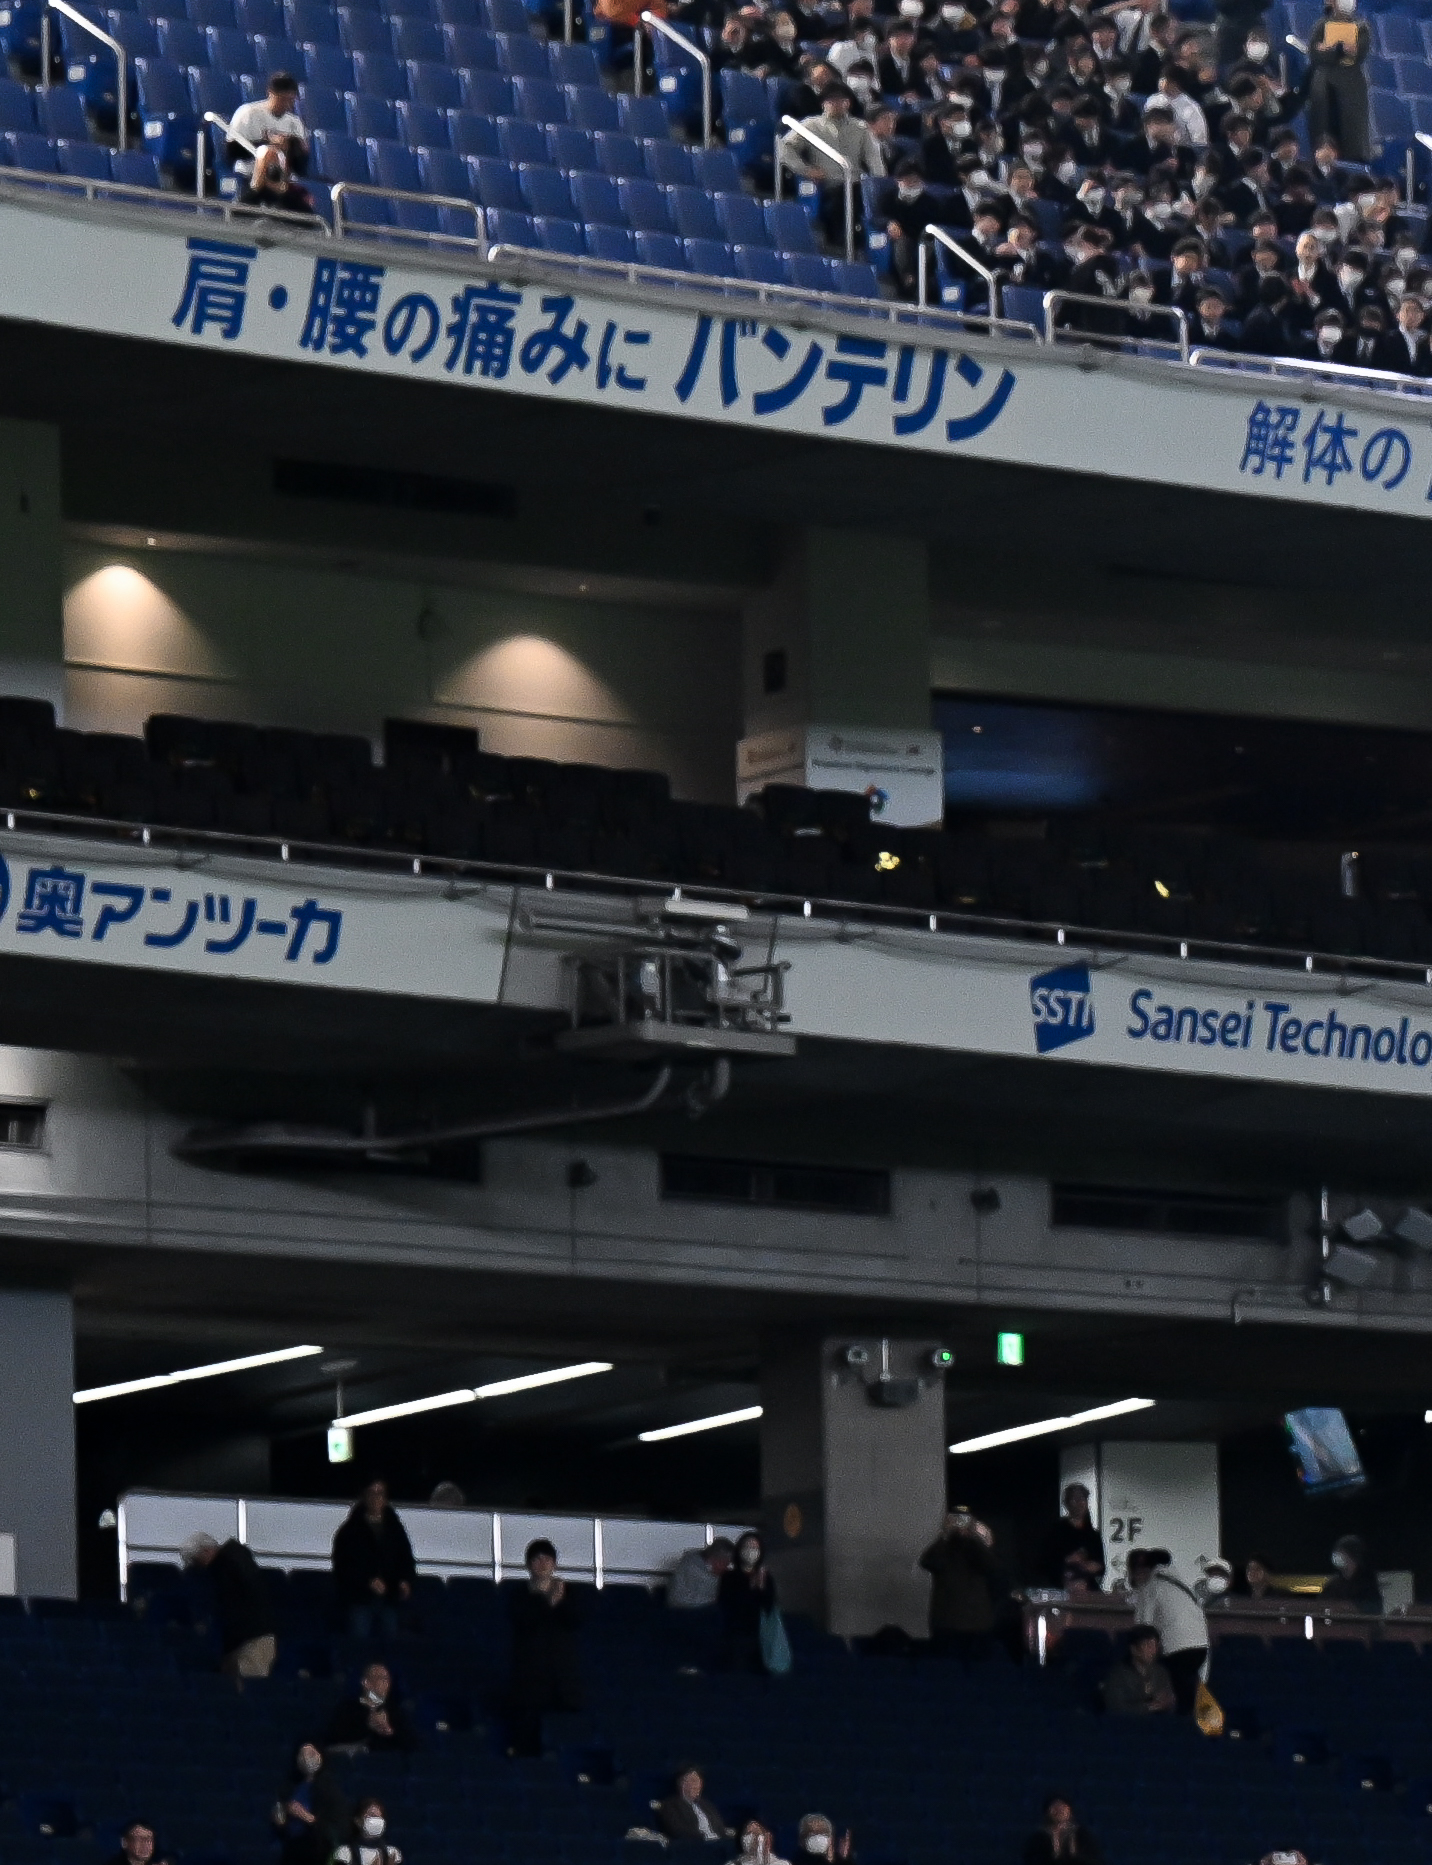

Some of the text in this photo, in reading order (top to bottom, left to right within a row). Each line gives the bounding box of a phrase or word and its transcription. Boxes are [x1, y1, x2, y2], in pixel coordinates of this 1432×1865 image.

[173, 238, 1015, 441] 肩・腰の痛みに バンテリン
[18, 867, 342, 965] 奥アンツーカ
[1127, 988, 1253, 1051] Sansei
[1109, 1517, 1142, 1543] 2F
